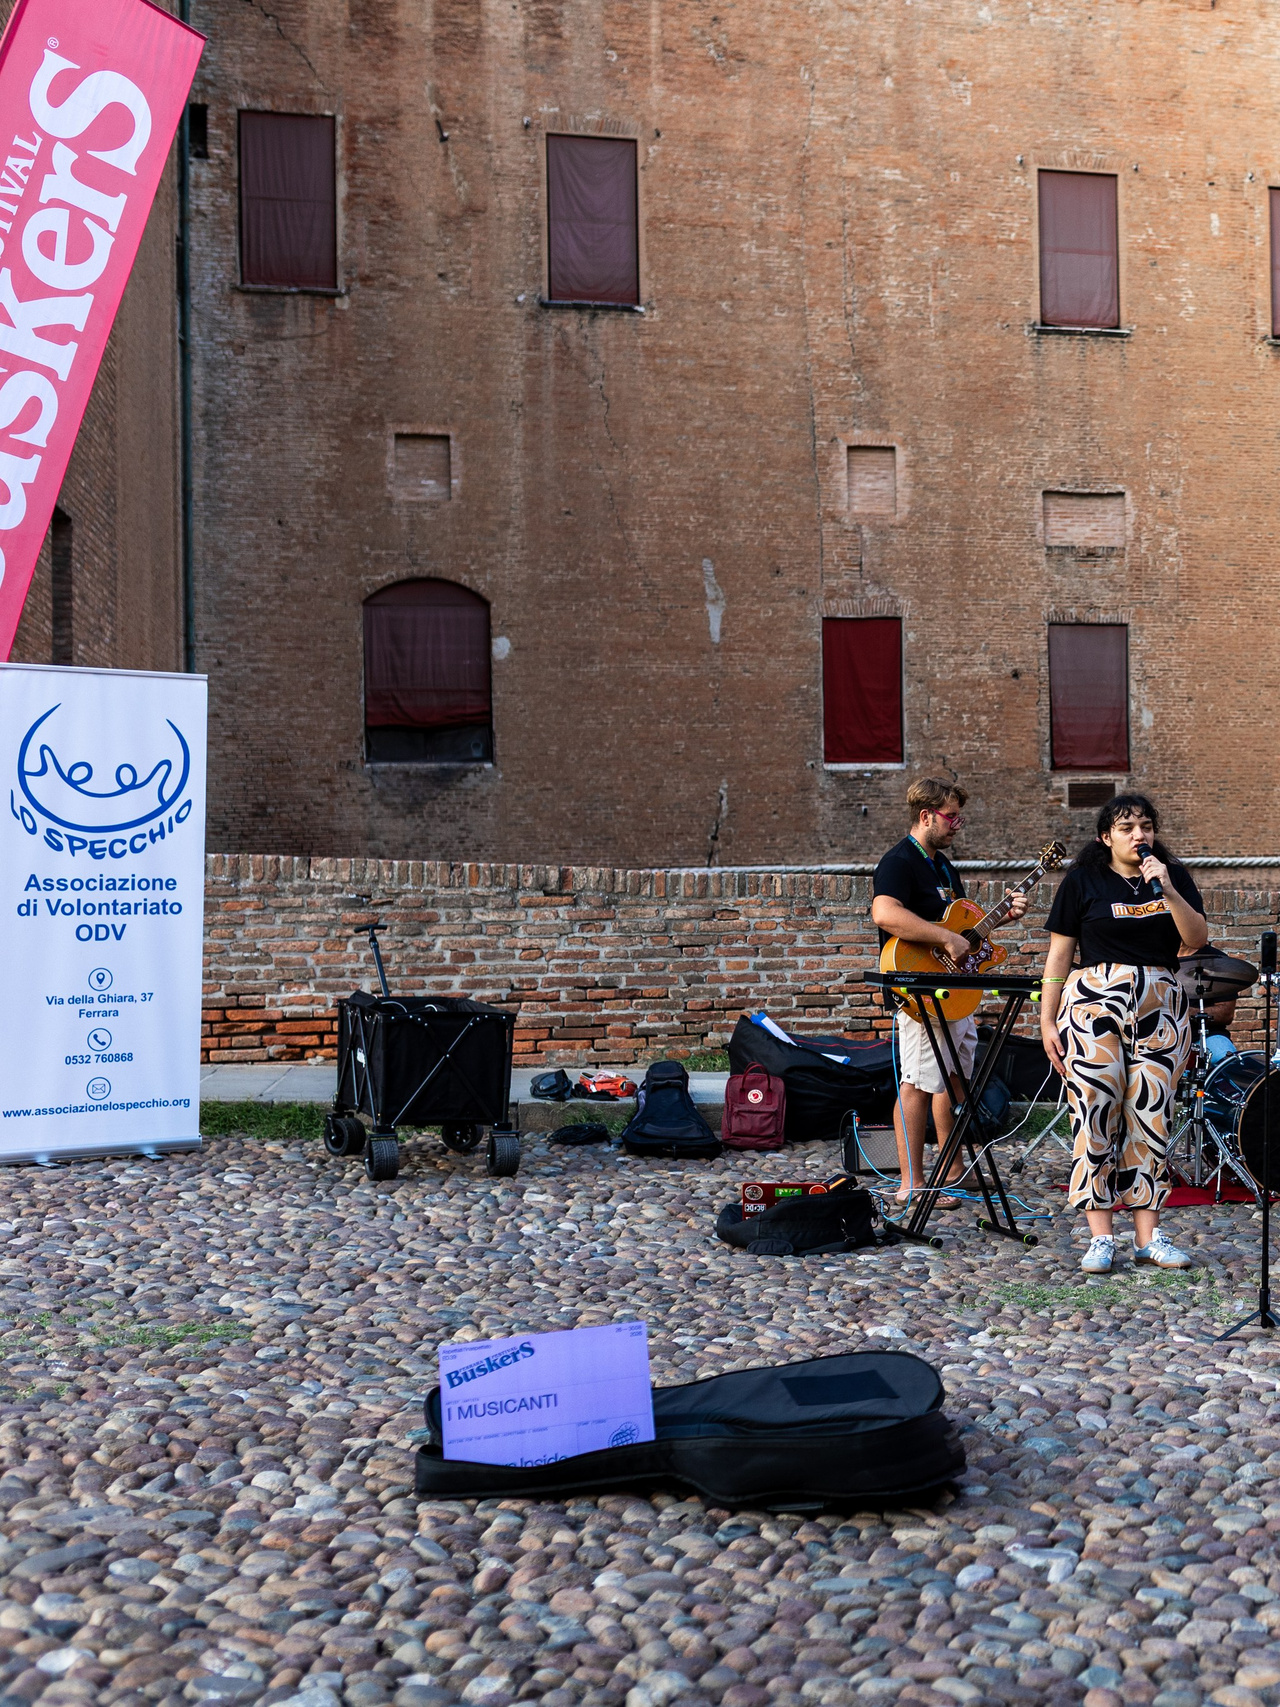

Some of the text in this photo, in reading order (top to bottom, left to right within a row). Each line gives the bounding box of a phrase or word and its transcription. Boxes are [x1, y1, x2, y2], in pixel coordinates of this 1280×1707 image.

[10, 788, 192, 860] LO SPECCHIO
[24, 873, 177, 892] Associazione
[17, 898, 183, 917] di Volontariato
[75, 924, 127, 942] ODV
[46, 992, 154, 1005] Via della Ghiara, 37
[78, 1008, 119, 1018] Ferrara
[65, 1052, 134, 1065] 0532 760868
[2, 1097, 190, 1118] www.associazionelospecchio.org
[445, 1341, 535, 1389] BuskerS
[447, 1393, 558, 1421] I MUSICANTI
